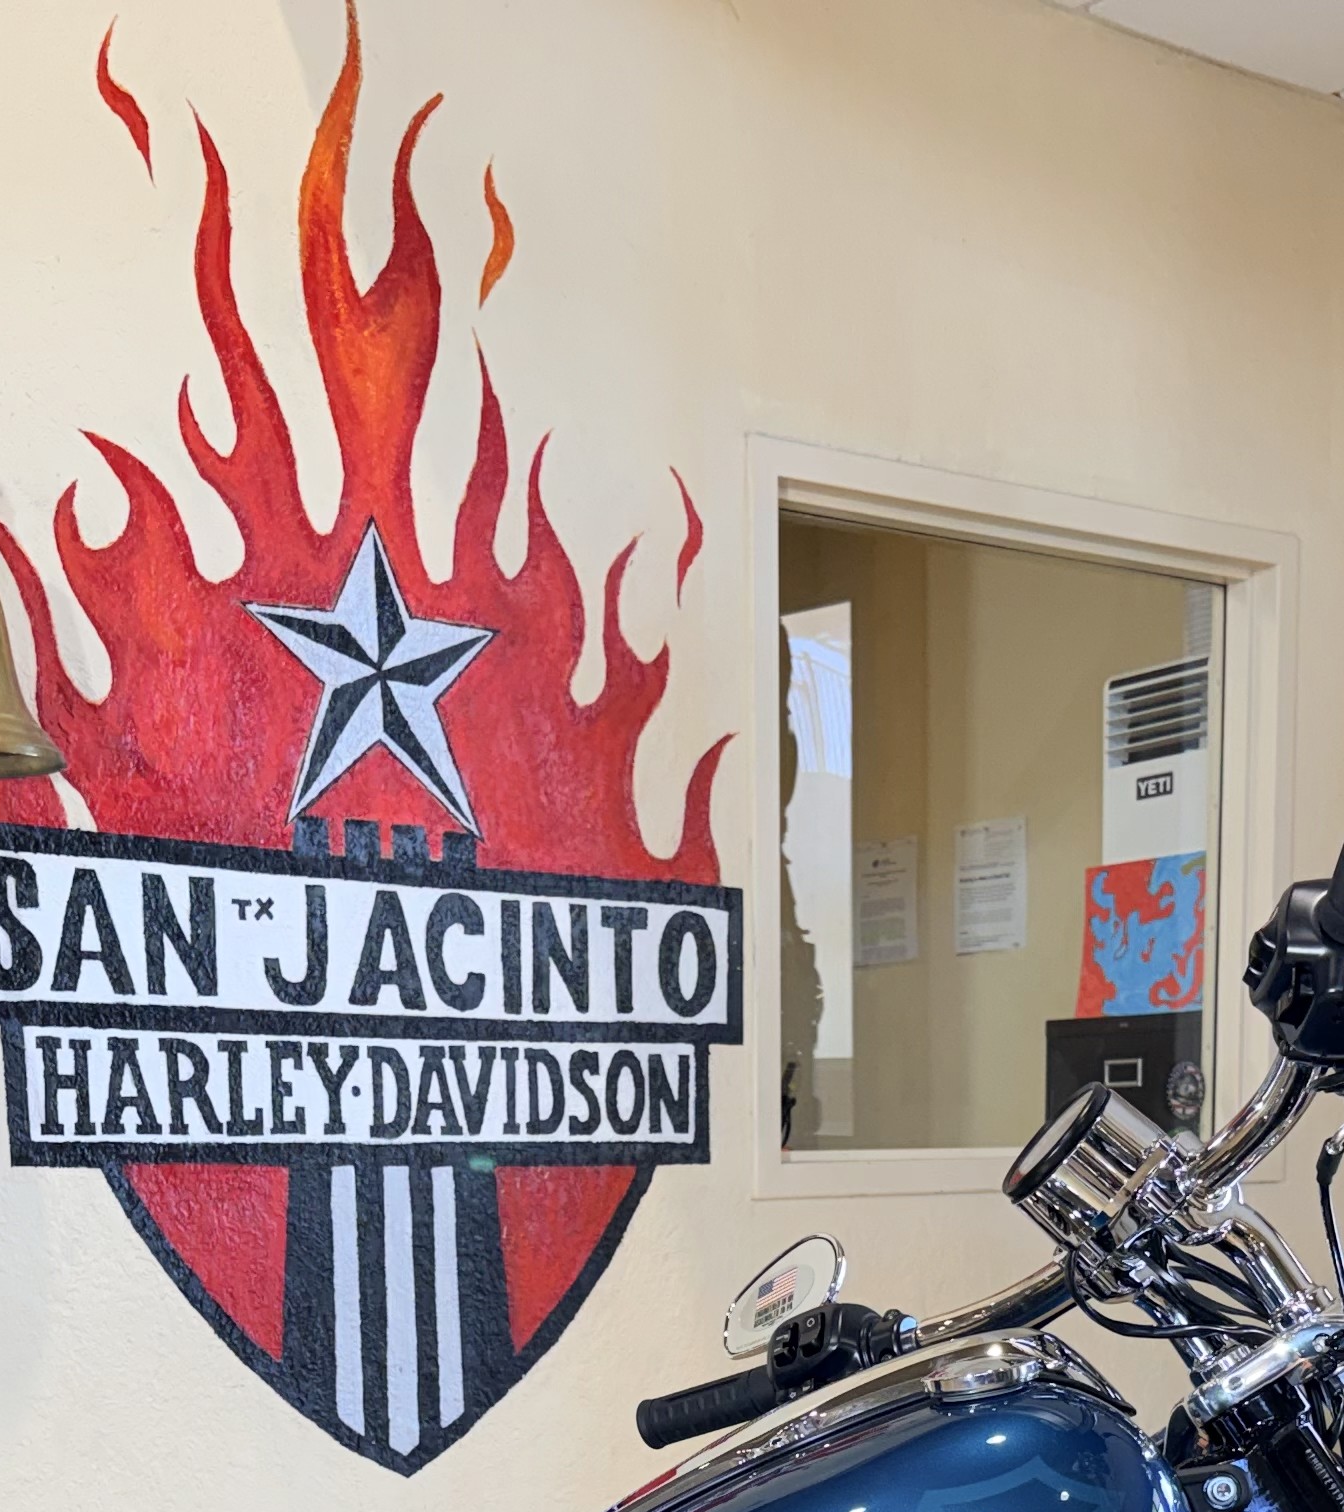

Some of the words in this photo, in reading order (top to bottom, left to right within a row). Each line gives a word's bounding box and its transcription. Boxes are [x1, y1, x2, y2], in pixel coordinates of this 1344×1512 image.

[1137, 775, 1172, 797] YETI
[231, 897, 275, 922] TX
[262, 884, 719, 1020] JACINTO
